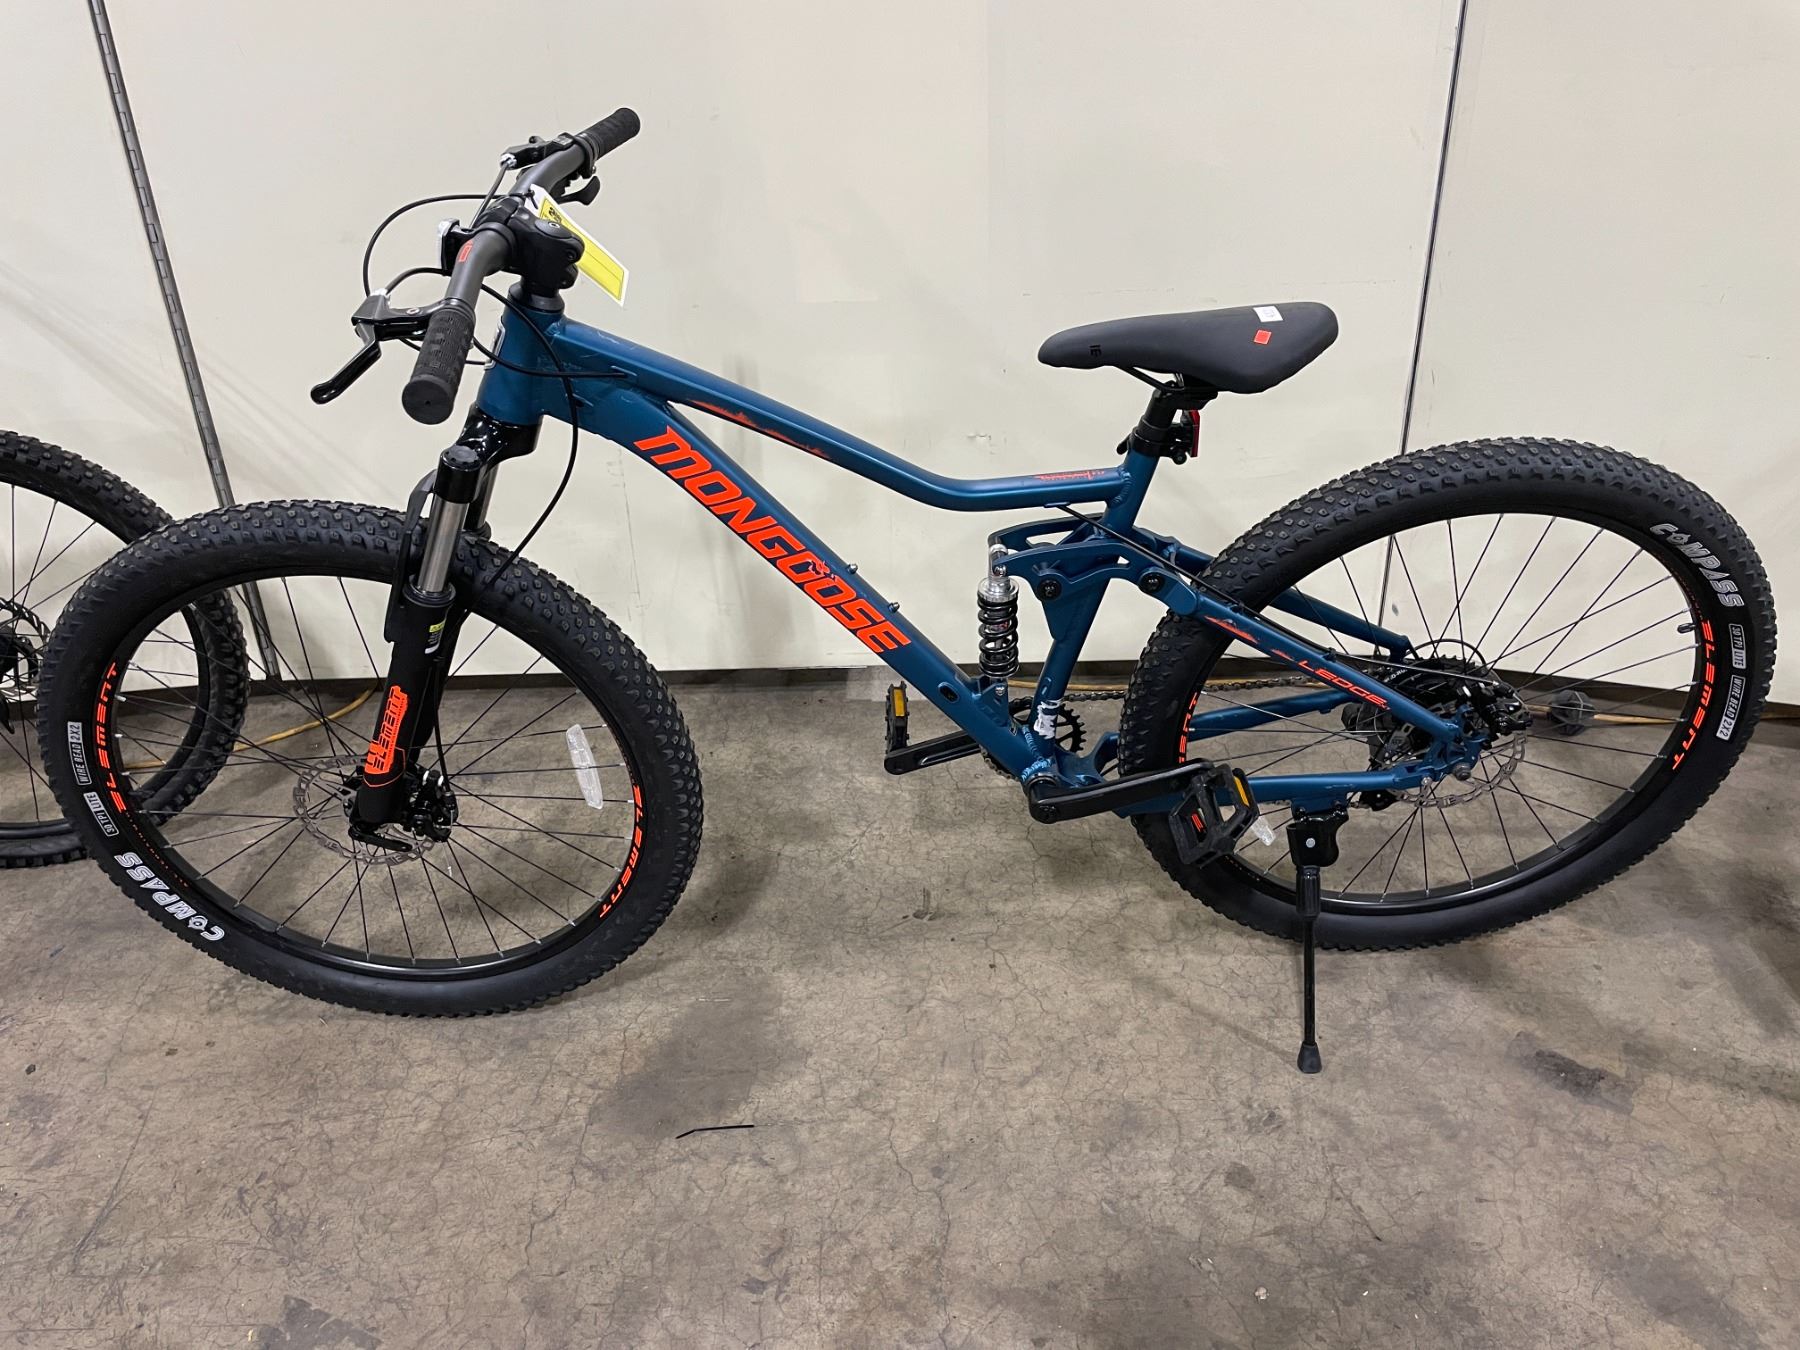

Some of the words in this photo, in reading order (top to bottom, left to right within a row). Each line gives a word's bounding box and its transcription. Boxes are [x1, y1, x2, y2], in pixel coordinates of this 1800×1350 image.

[633, 425, 912, 653] MONGOOSE
[1649, 523, 1745, 607] COMPASS
[1733, 636, 1743, 649] TPI
[1734, 650, 1745, 668] LITE
[1297, 660, 1388, 708] LEDGE
[1732, 677, 1743, 696] WIRE
[1672, 620, 1715, 770] ELEMENT
[1725, 696, 1739, 718] BEAD
[69, 723, 82, 742] 2X2
[96, 662, 126, 814] ELEMENT
[1718, 719, 1733, 737] 2X2
[70, 743, 84, 762] BEAD
[75, 763, 90, 783] WIRE
[86, 792, 102, 813] LITE
[96, 811, 109, 826] TPI
[113, 851, 226, 941] COMPASS
